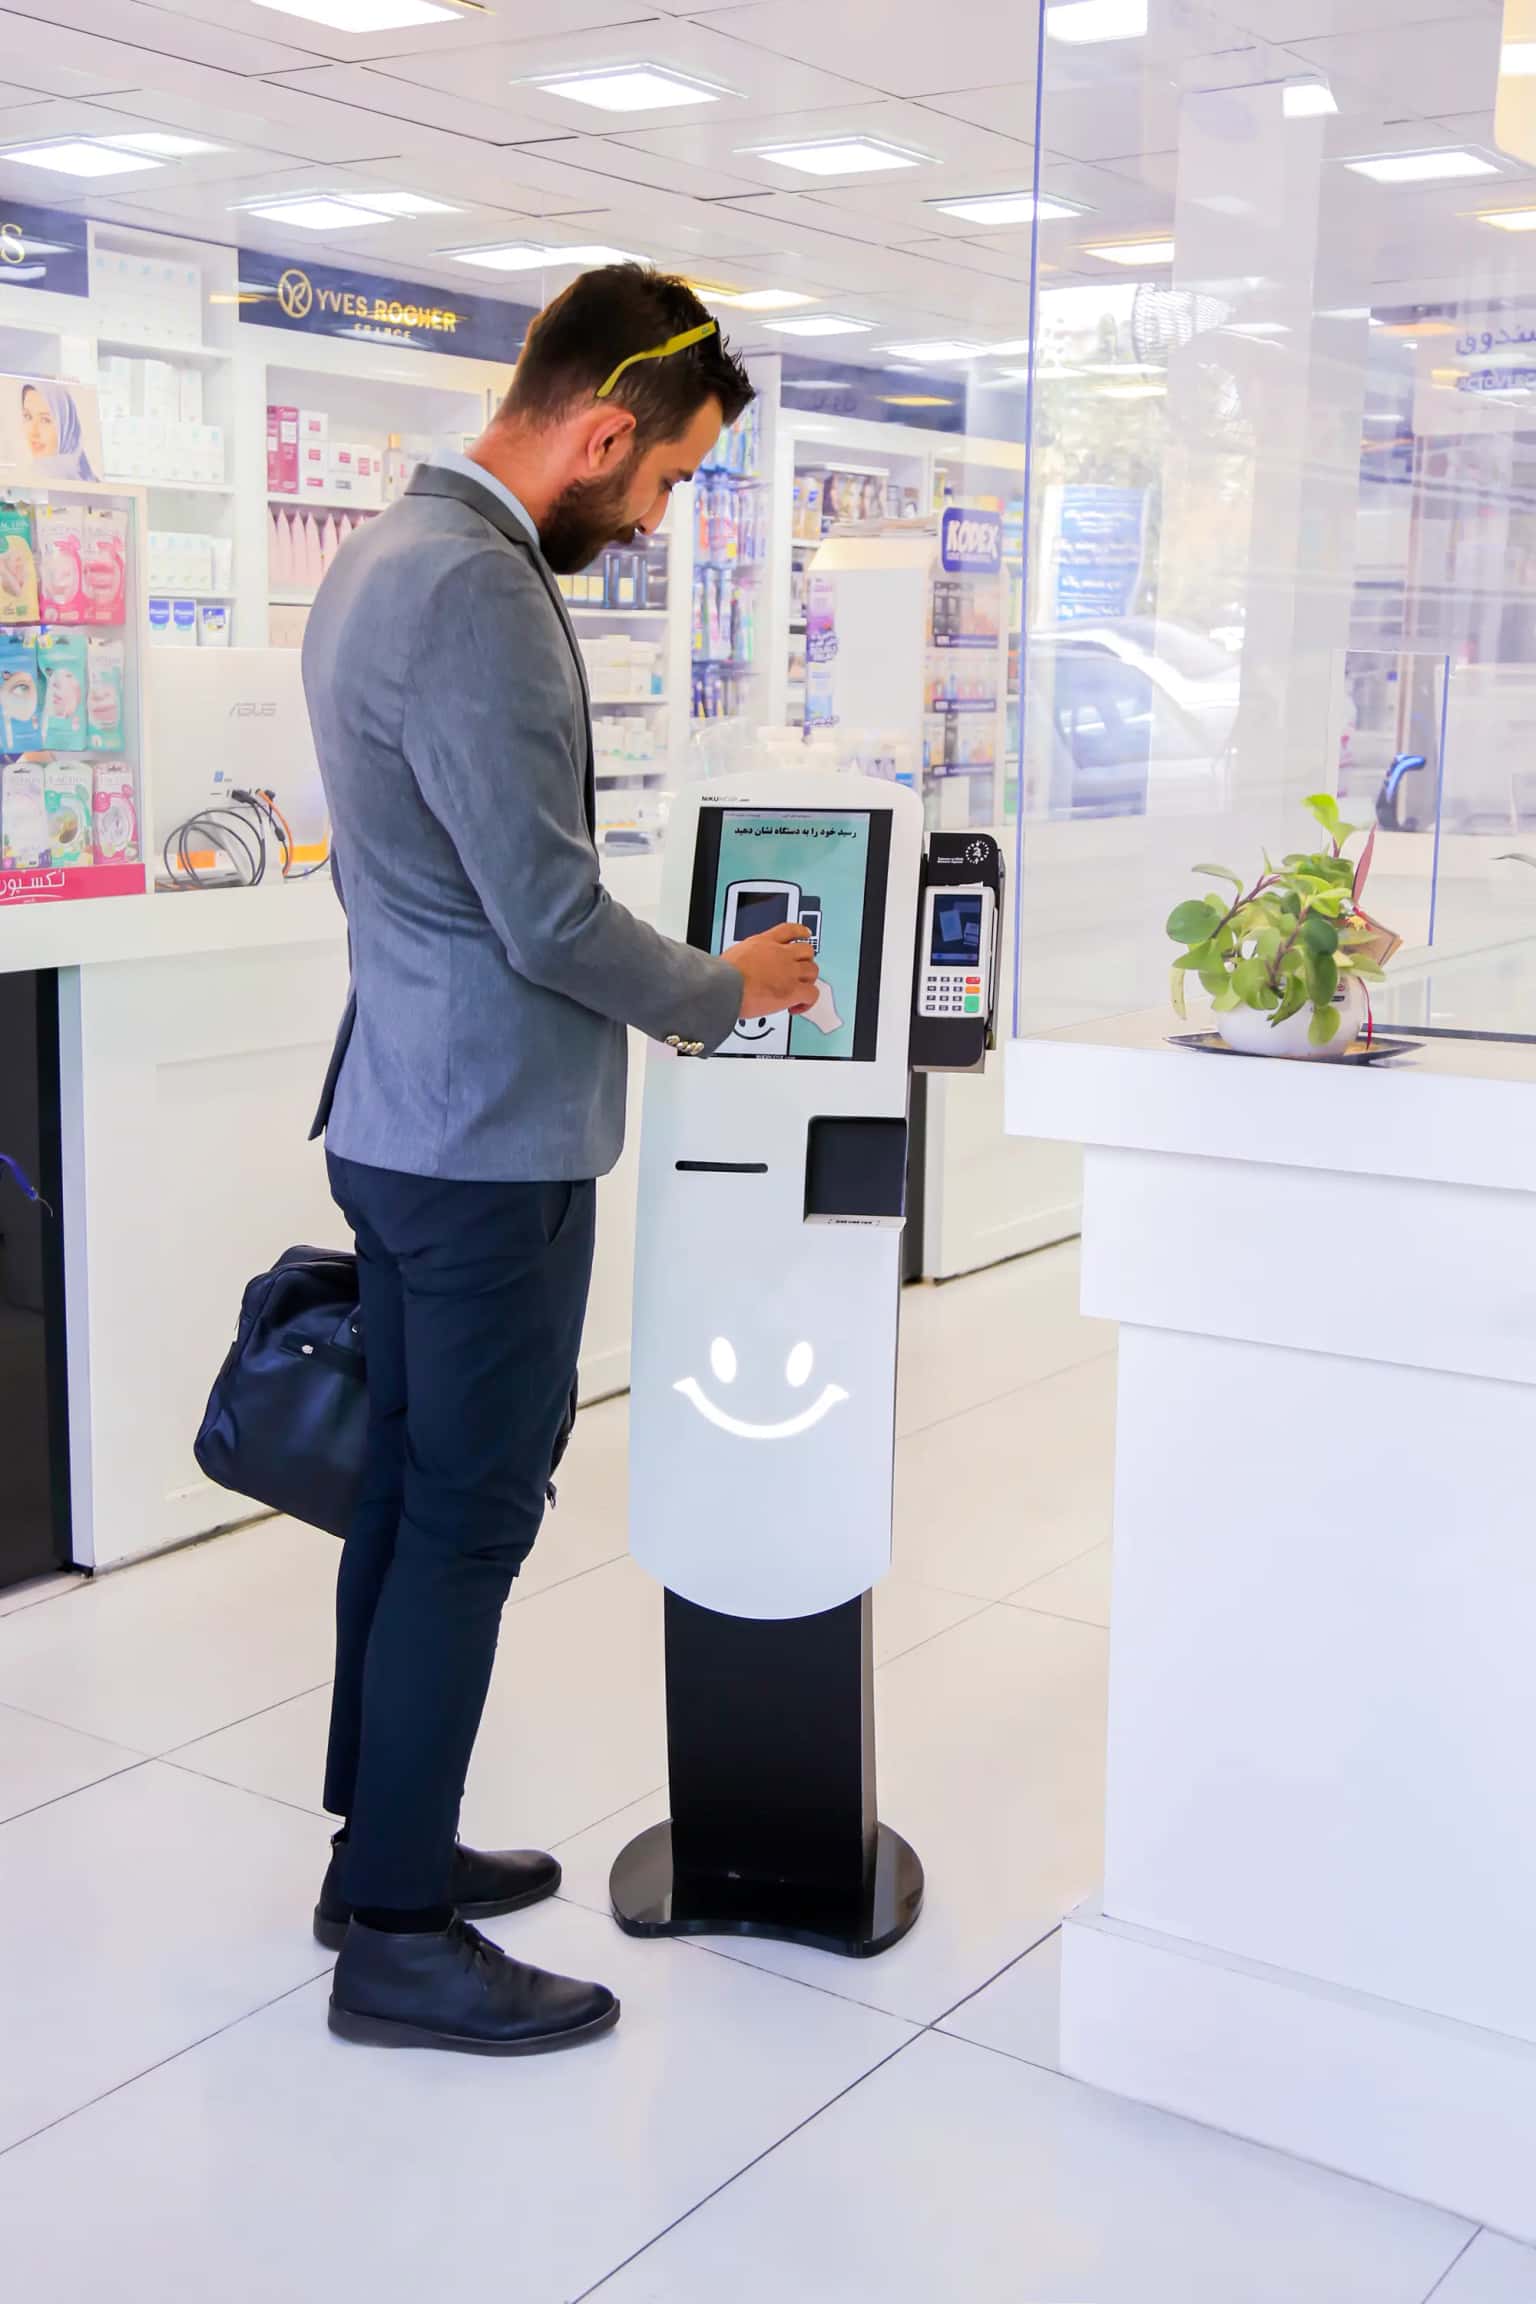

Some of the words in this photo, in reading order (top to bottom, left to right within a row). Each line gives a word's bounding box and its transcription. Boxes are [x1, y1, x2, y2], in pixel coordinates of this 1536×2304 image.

[316, 288, 368, 318] YVES
[373, 298, 457, 333] ROCHER
[229, 702, 278, 718] ASUS
[734, 827, 753, 835] دهید
[754, 825, 773, 836] نشان
[774, 826, 800, 835] دستگاه
[802, 828, 810, 837] به
[811, 827, 819, 837] را
[820, 827, 836, 837] خود
[837, 828, 857, 838] رسید
